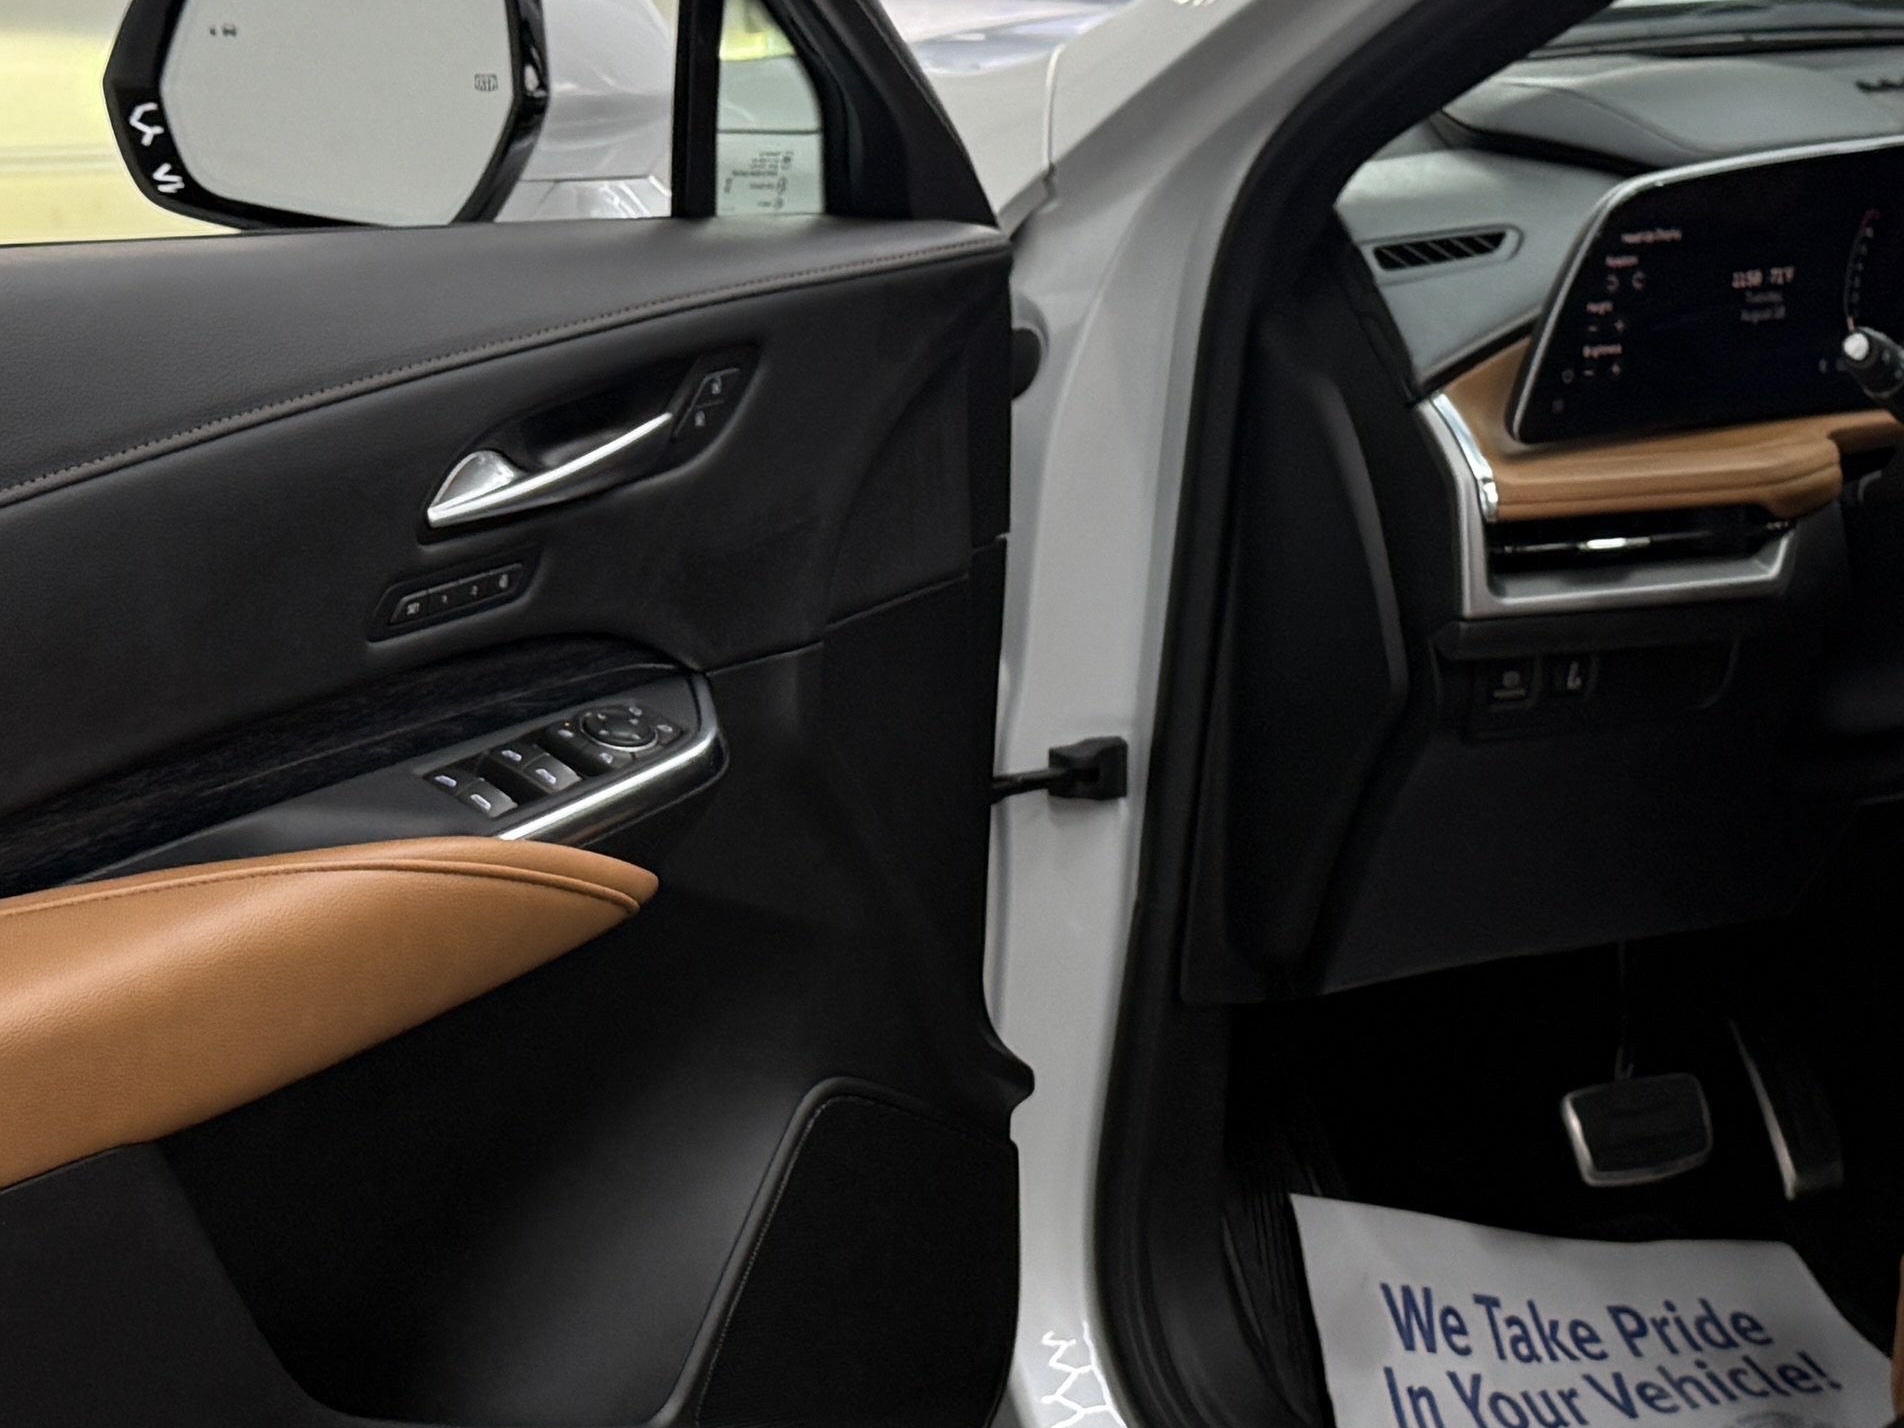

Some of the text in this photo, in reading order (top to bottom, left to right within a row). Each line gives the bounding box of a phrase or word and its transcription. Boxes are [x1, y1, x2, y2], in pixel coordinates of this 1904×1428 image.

[1381, 1282, 1774, 1366] We Take Pride
[1584, 1350, 1842, 1420] Vehicle!
